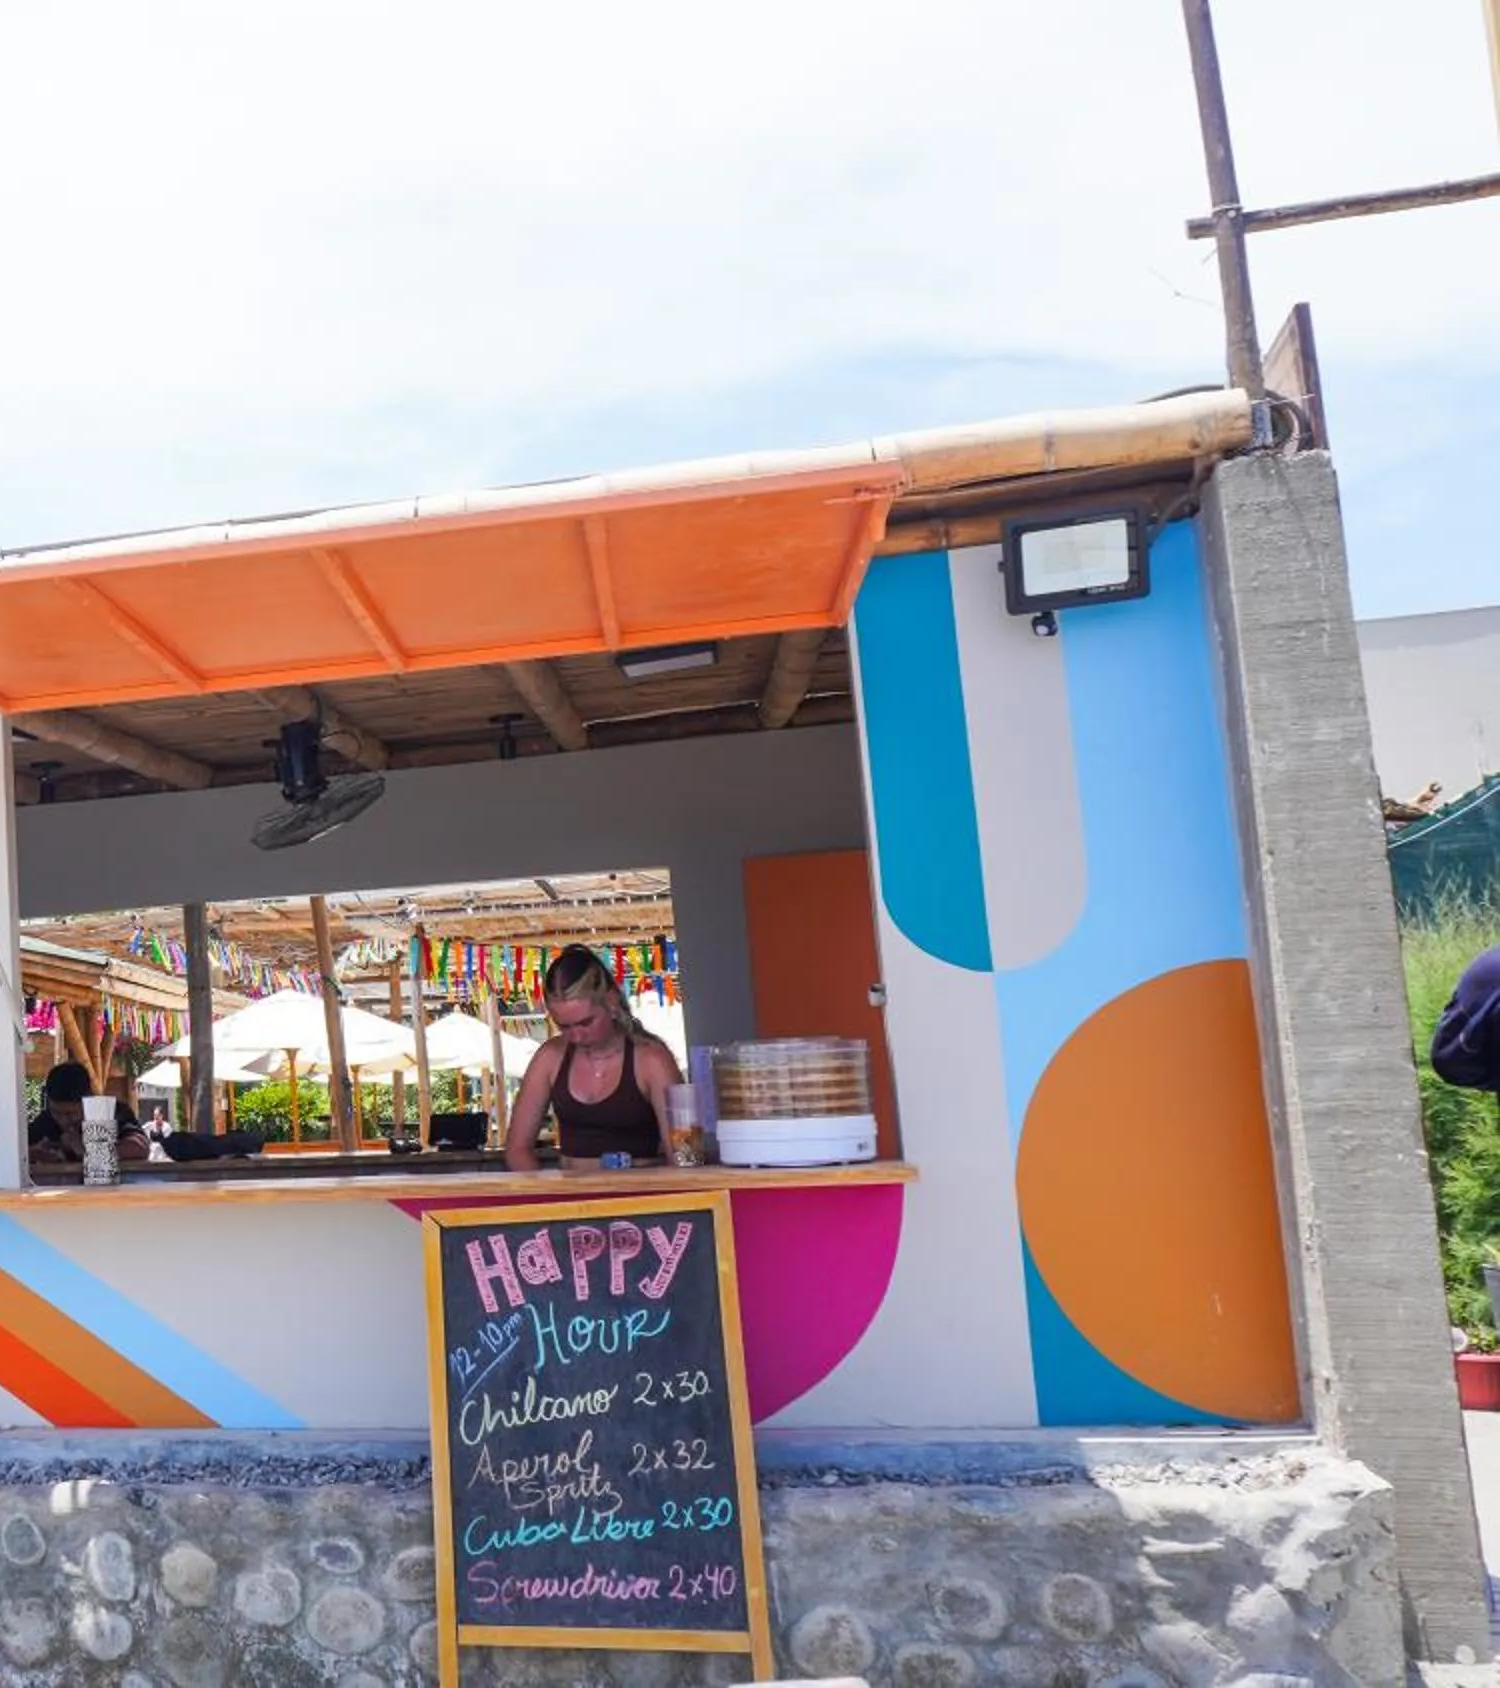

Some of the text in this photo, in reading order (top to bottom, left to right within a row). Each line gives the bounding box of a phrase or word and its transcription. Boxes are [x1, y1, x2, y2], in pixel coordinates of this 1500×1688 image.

[459, 1375, 619, 1445] Chilcano
[468, 1429, 594, 1500] Aperol
[571, 1506, 654, 1543] Libre
